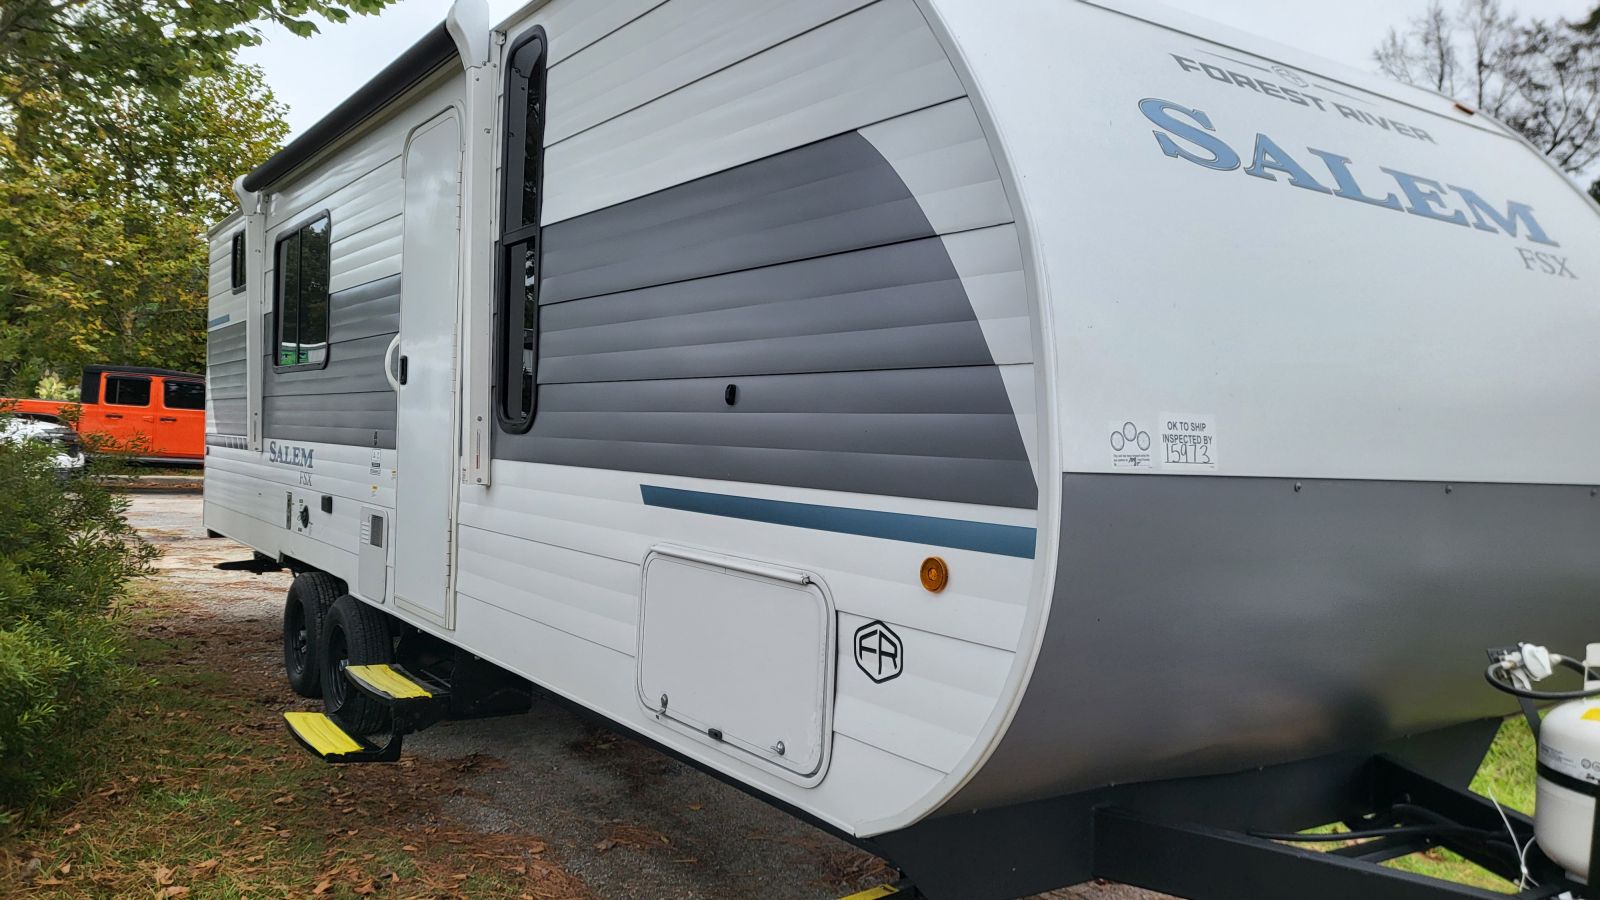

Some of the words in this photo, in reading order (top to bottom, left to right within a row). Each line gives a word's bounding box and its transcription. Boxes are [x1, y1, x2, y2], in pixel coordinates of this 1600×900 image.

[1168, 53, 1327, 112] FOREST
[1328, 101, 1438, 145] RIVER
[1138, 98, 1560, 247] SALEM
[1515, 247, 1578, 279] FSX
[1167, 421, 1178, 431] OK
[1179, 421, 1189, 431] TO
[1190, 422, 1206, 431] SHIP
[1162, 434, 1202, 444] INSPECTED
[1203, 435, 1212, 445] BY
[269, 441, 314, 468] SALEM
[1165, 443, 1211, 464] 15973
[299, 470, 313, 487] FSX
